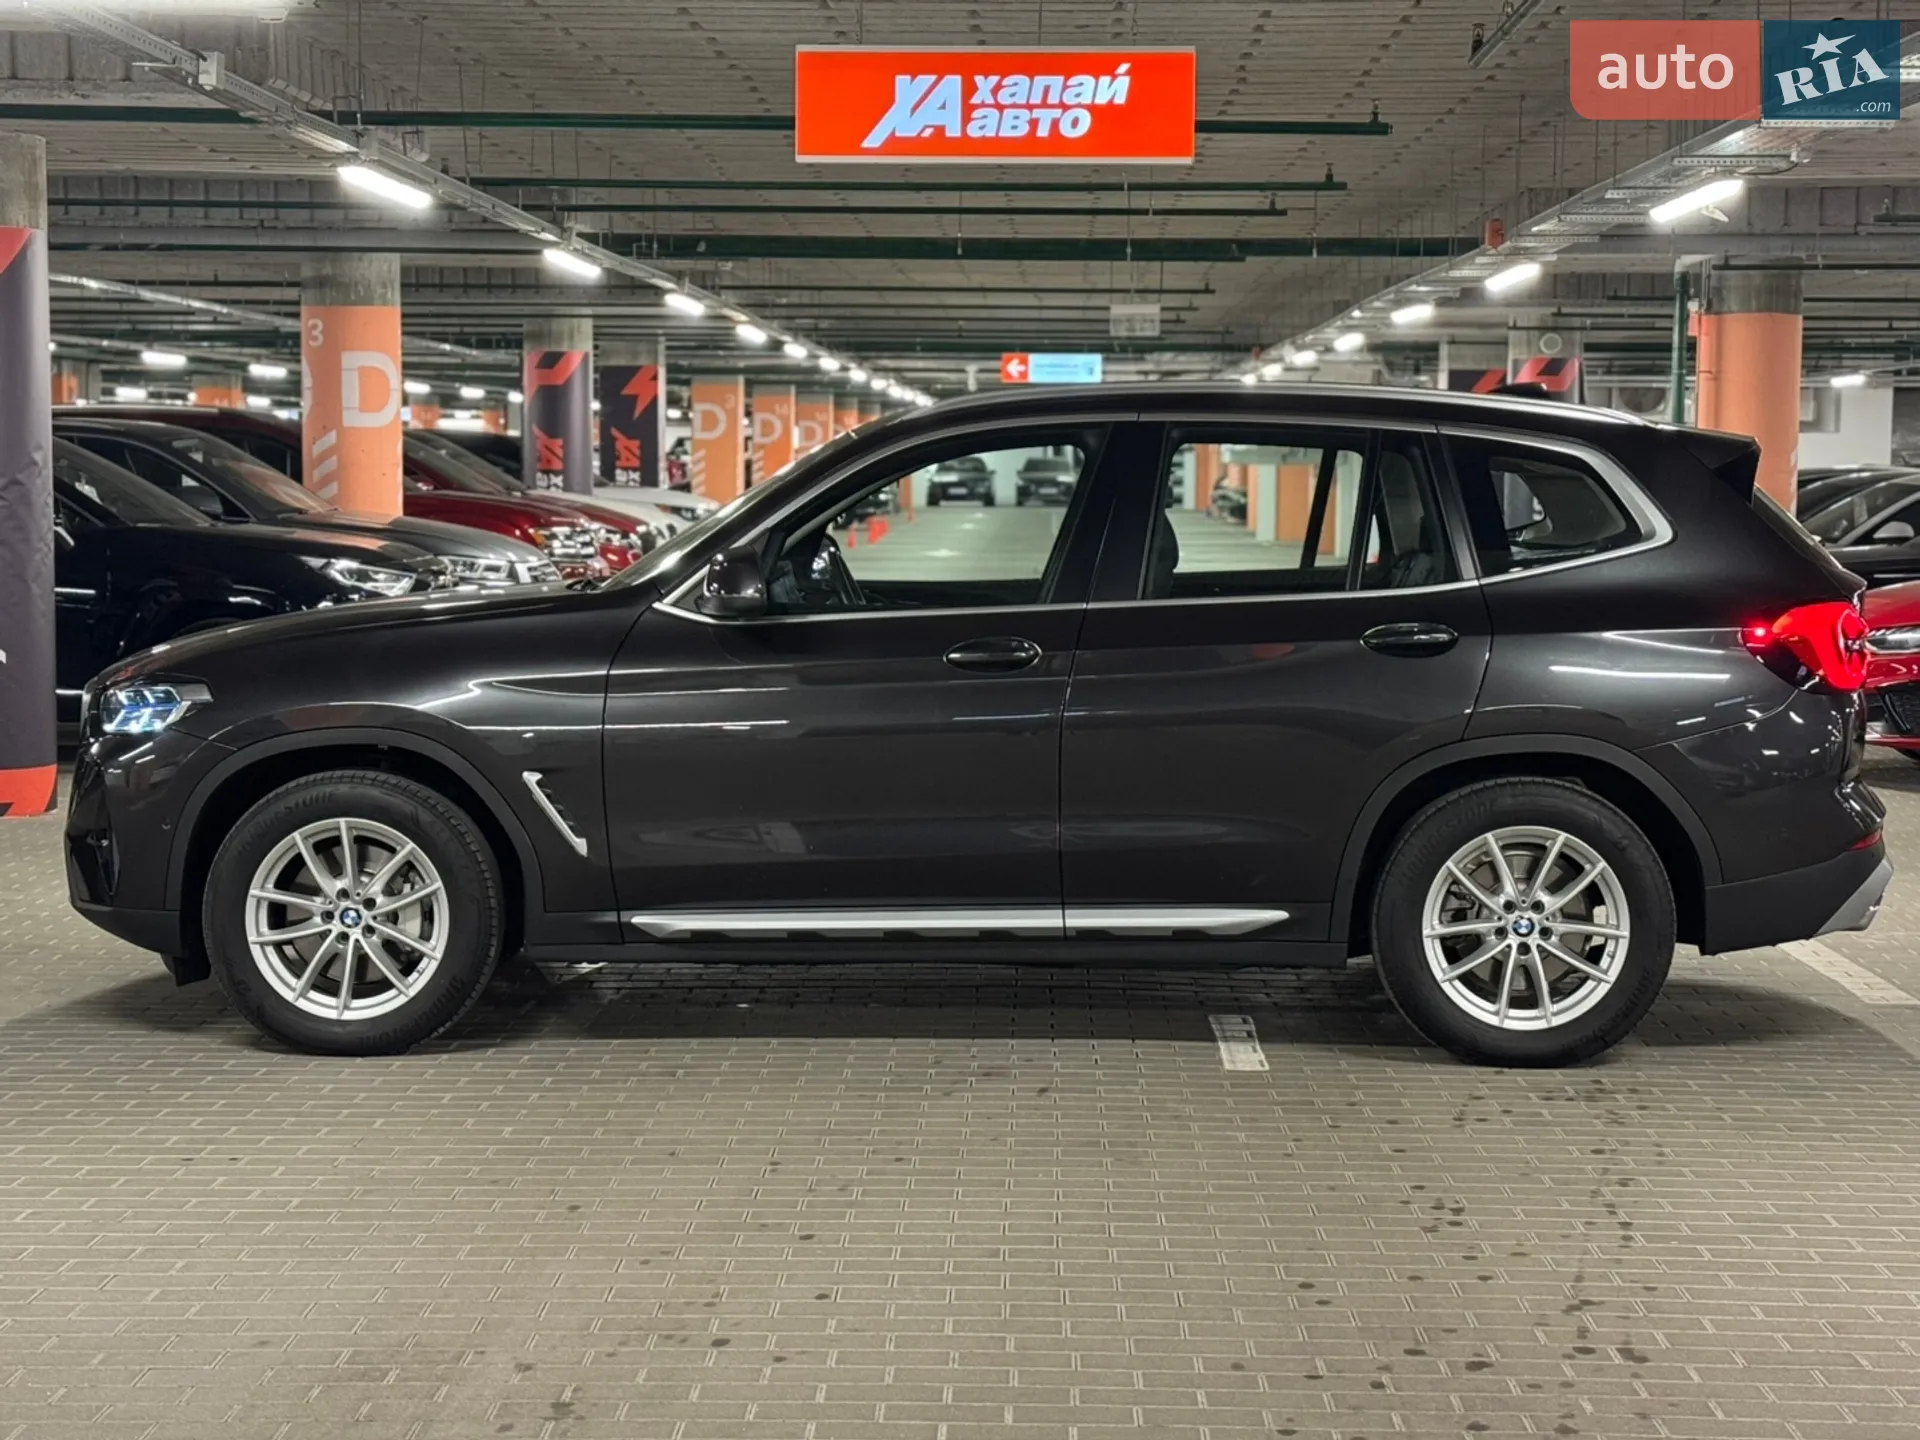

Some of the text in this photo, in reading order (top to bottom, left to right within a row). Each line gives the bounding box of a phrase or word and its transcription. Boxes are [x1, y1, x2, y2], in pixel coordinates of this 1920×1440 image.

[969, 62, 1132, 105] хапай
[966, 107, 1092, 138] авто
[307, 318, 324, 347] 3
[341, 350, 399, 428] D
[693, 402, 728, 439] D
[753, 412, 784, 444] D
[797, 419, 824, 447] D
